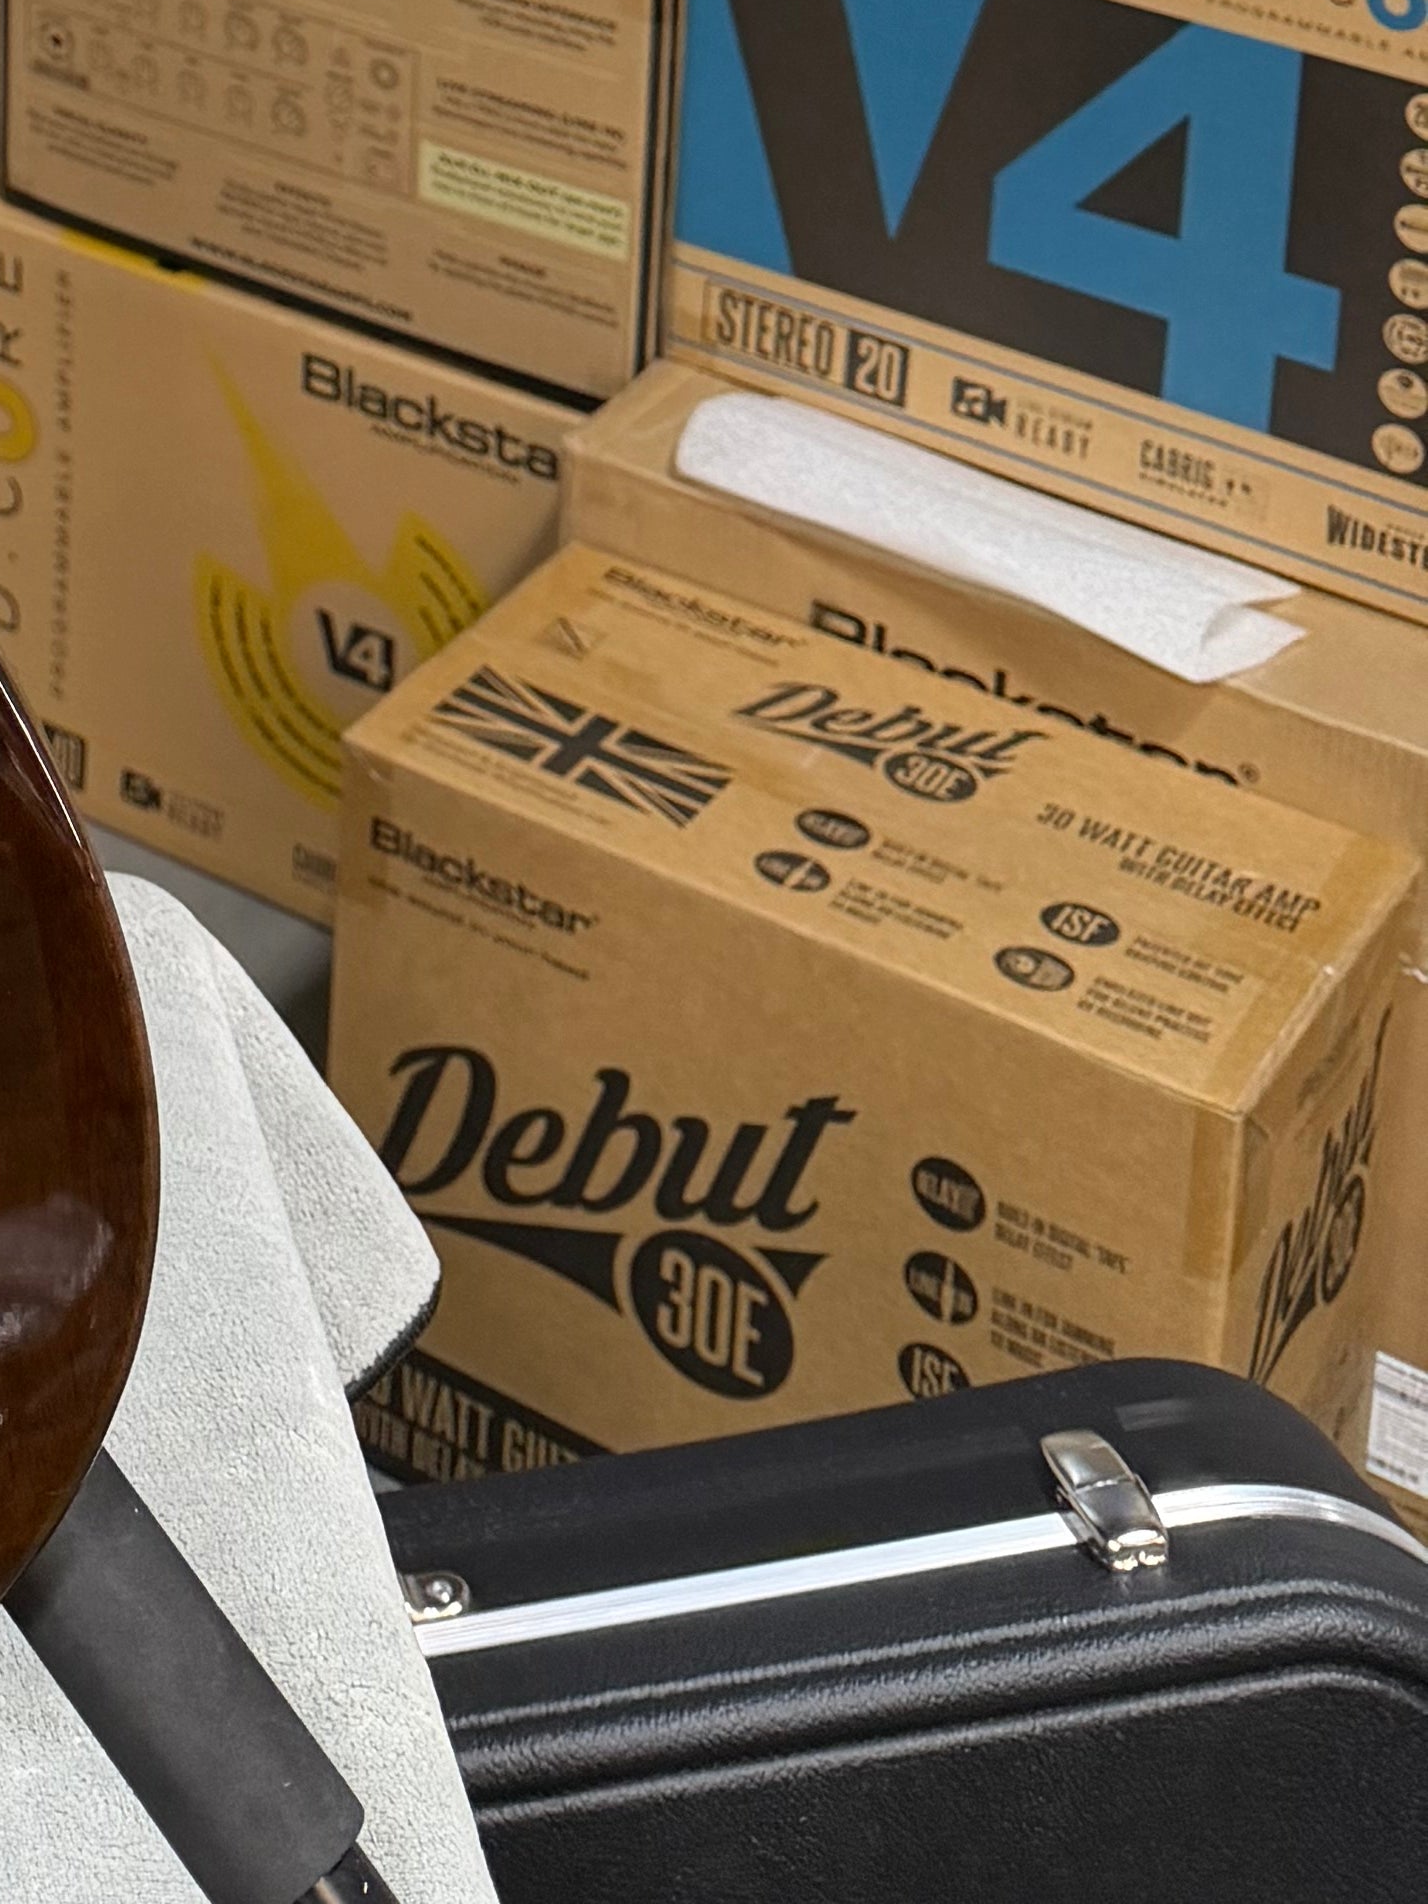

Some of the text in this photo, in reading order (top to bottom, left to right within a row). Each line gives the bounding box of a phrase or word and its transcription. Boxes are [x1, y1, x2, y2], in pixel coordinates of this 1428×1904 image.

[713, 290, 903, 401] STEREO 20
[300, 350, 560, 482] Blacksta
[734, 679, 1052, 764] Debut
[370, 816, 592, 934] Blackstar
[1035, 801, 1324, 913] 30 WATT GUITAR AMP
[1051, 904, 1109, 942] ISF
[384, 1044, 856, 1232] Debut
[656, 1252, 764, 1389] 30E
[397, 1362, 496, 1462] WATT
